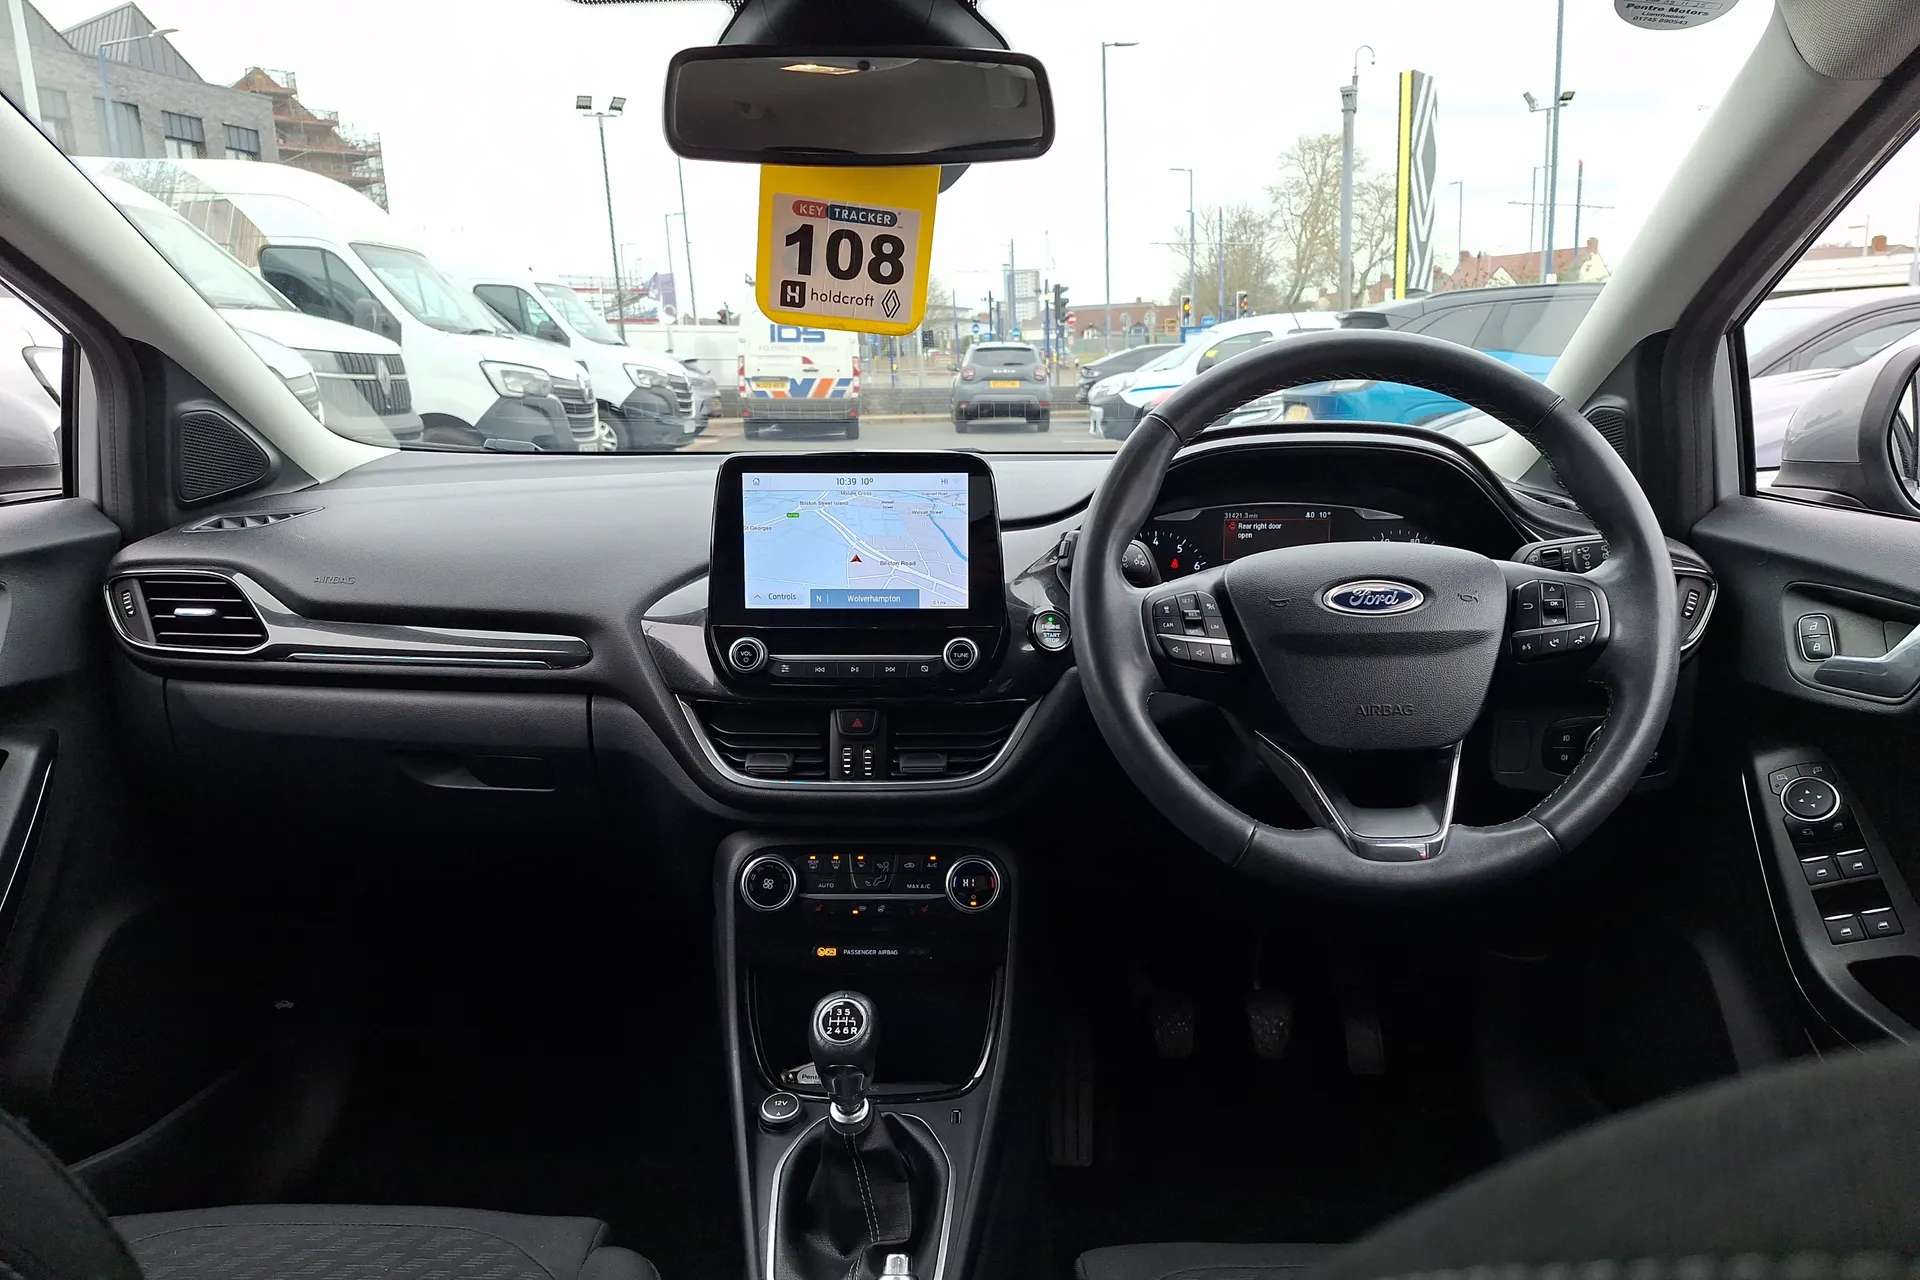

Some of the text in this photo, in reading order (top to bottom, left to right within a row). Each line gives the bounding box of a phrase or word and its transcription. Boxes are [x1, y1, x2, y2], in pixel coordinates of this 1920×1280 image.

[1626, 3, 1665, 12] Pentre
[1668, 7, 1710, 16] Motors
[799, 203, 892, 225] KEY TRACKER
[785, 223, 905, 285] 108
[810, 287, 875, 308] holdcroft
[836, 477, 857, 486] 10:39
[1253, 522, 1267, 531] right
[1153, 537, 1159, 546] 4
[1177, 544, 1183, 553] 5
[1194, 561, 1200, 570] 6
[313, 576, 357, 585] AIRBAG
[768, 592, 797, 601] Controls
[847, 593, 901, 604] Wolverhampton
[1349, 588, 1399, 606] Ford
[1357, 703, 1416, 717] AIRBAG
